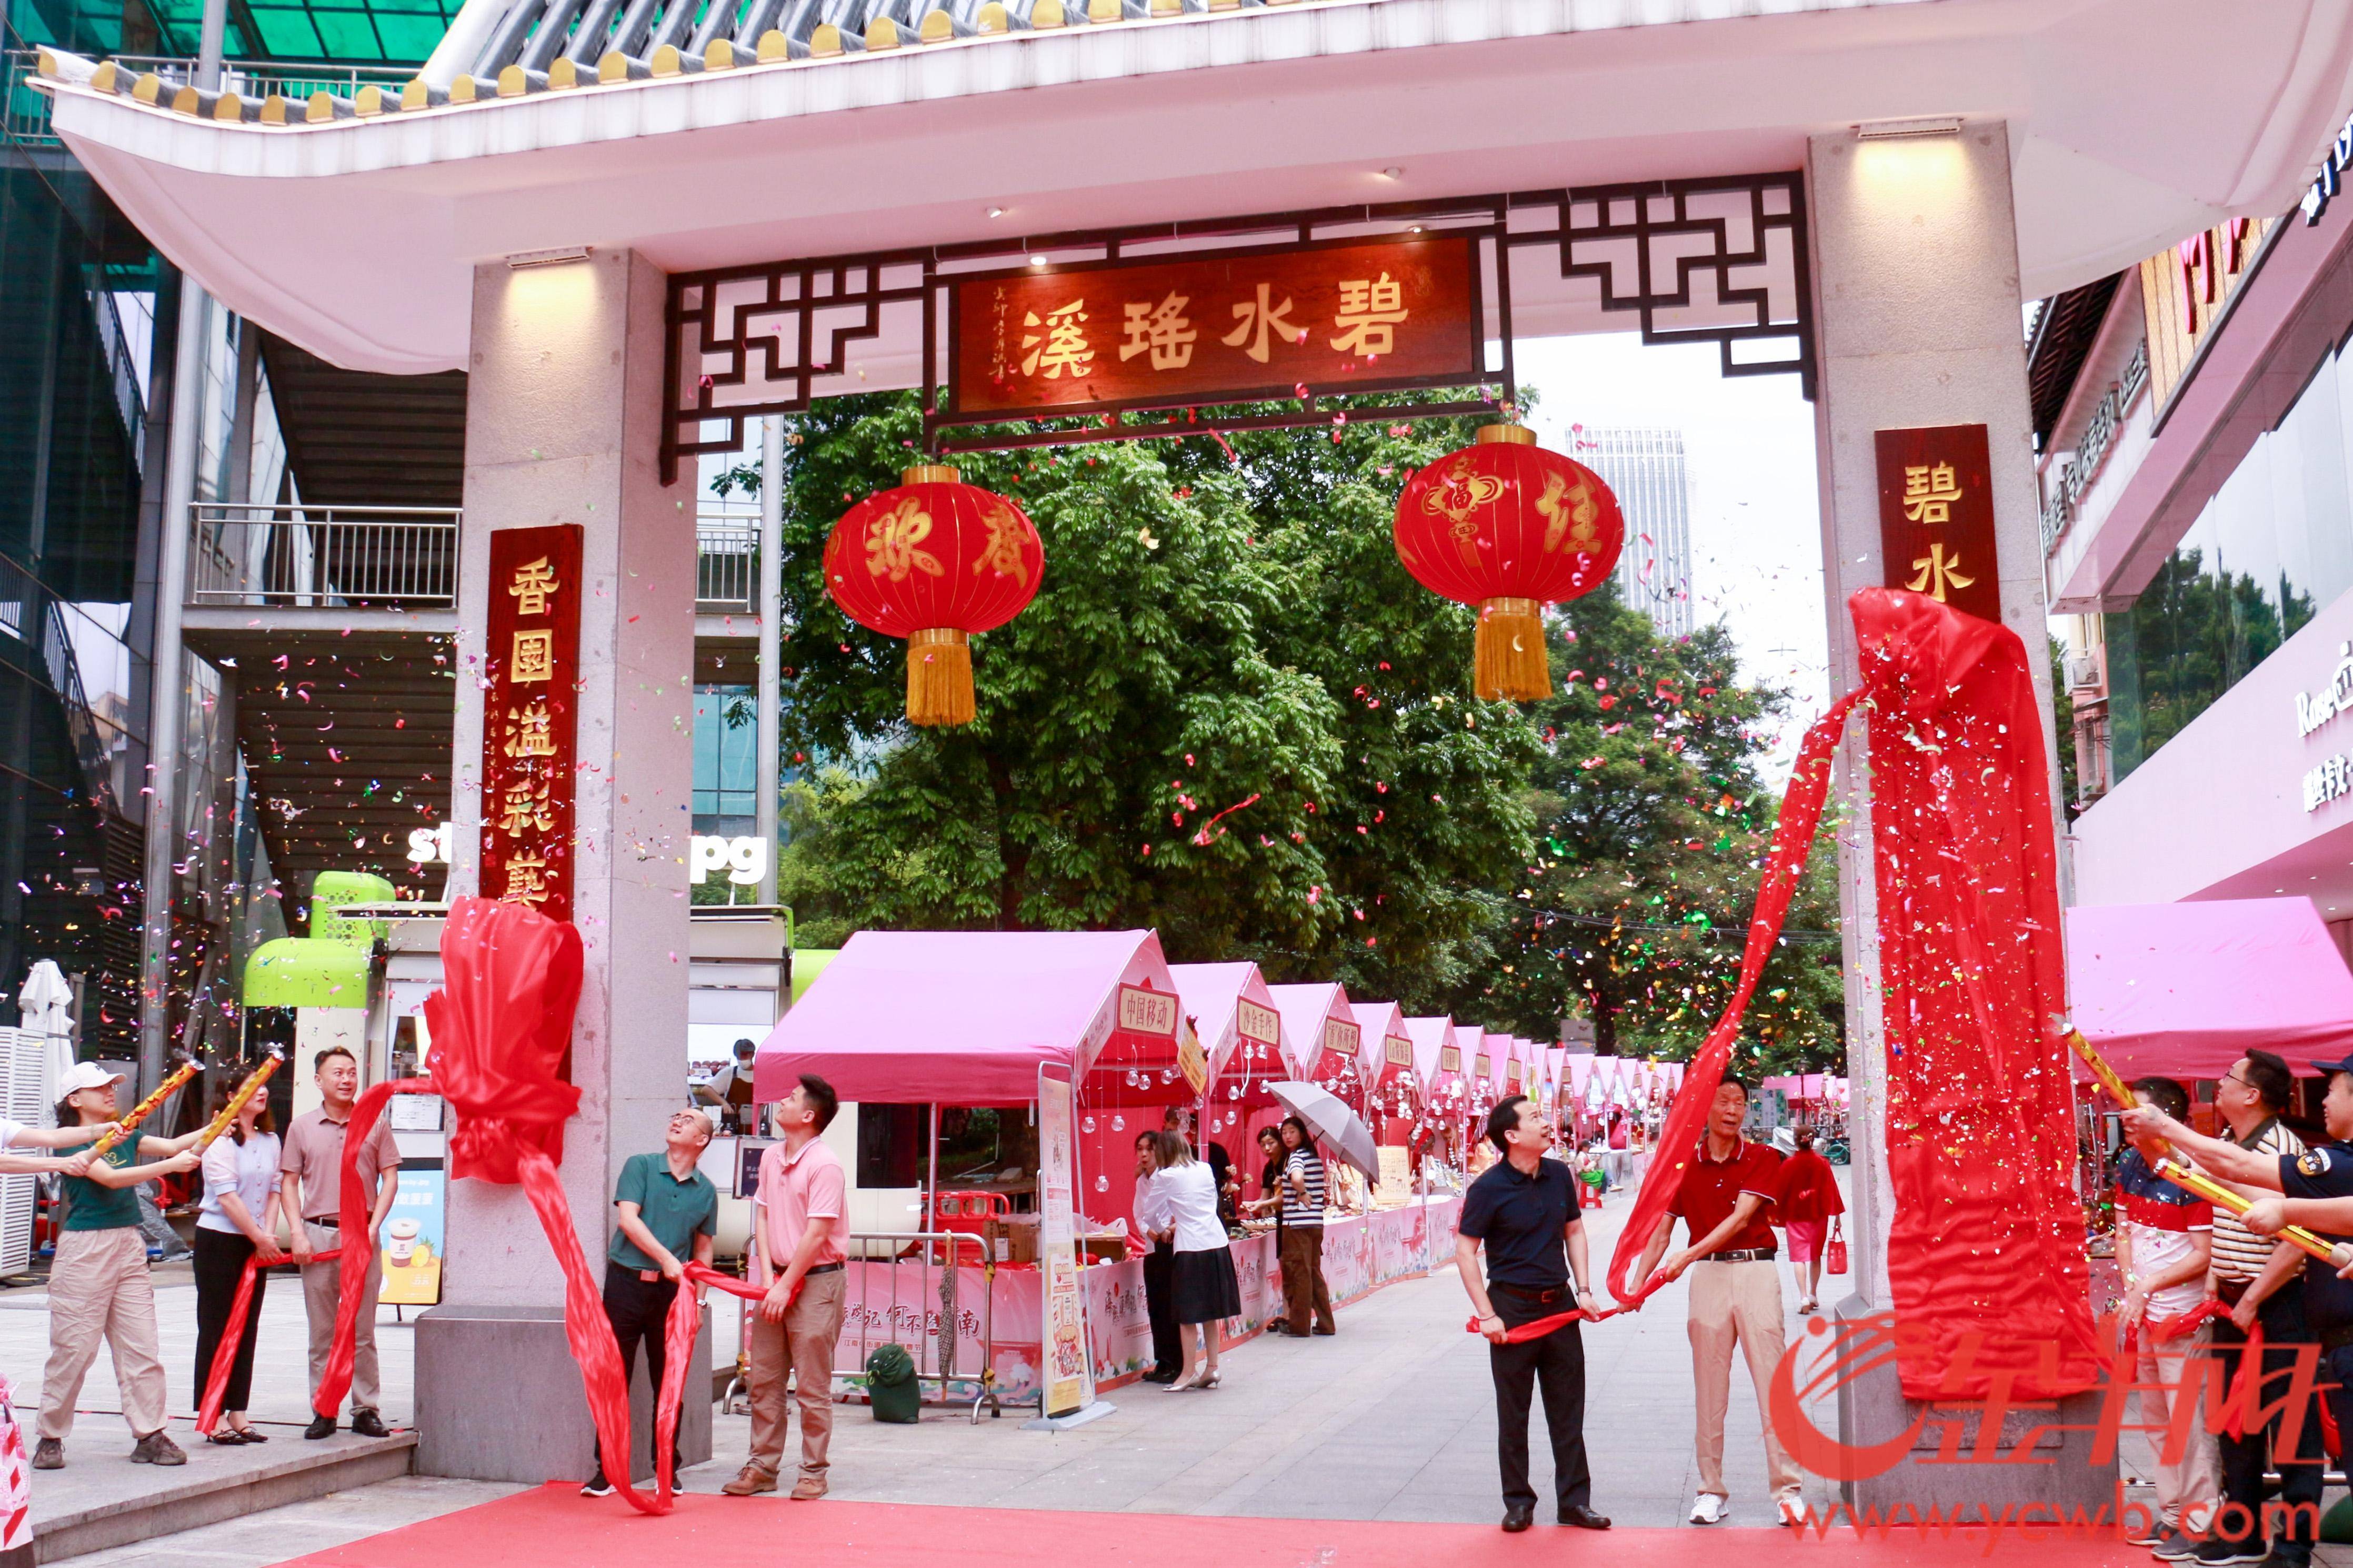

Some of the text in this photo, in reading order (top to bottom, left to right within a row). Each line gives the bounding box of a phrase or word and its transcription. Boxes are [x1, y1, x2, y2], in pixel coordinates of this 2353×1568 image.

[1441, 477, 1473, 511] 福
[1903, 459, 1976, 603] 碧水
[2295, 687, 2334, 738] Rose
[1127, 993, 1167, 1030] 中国移动
